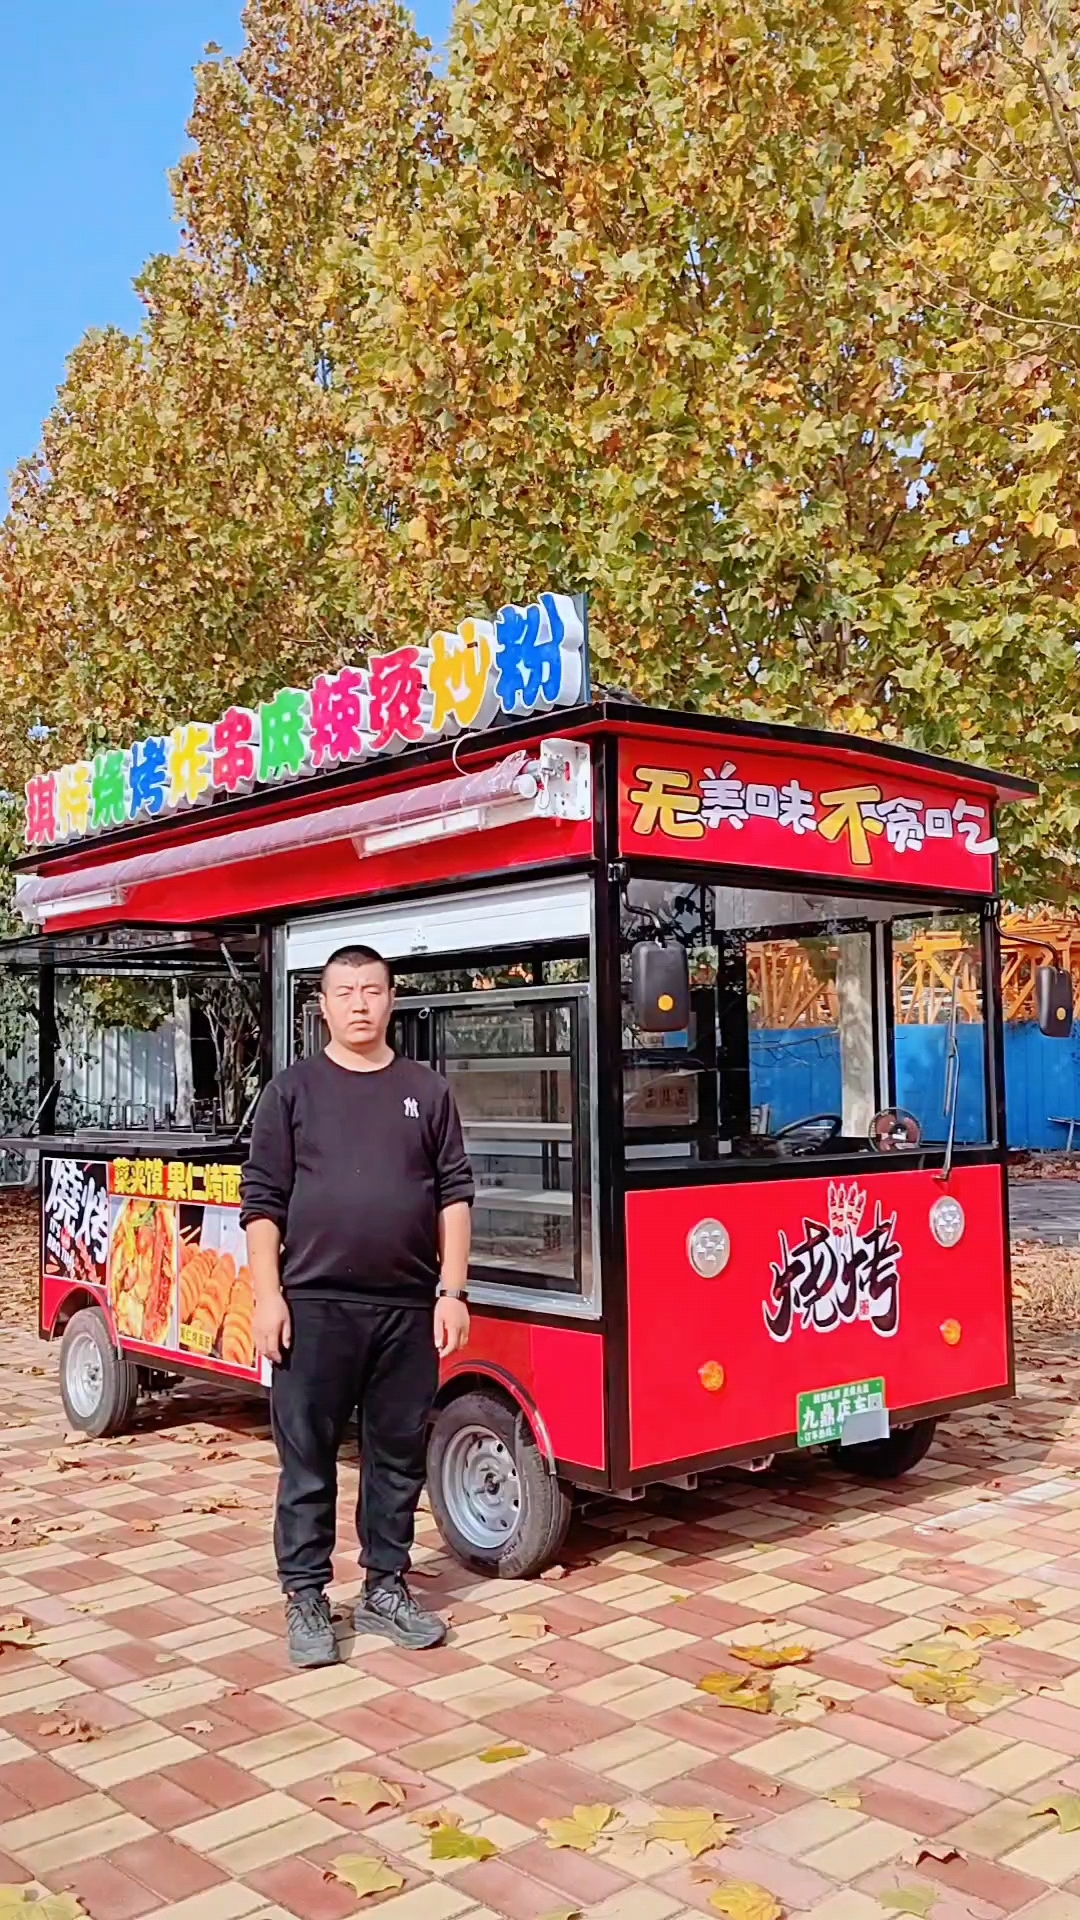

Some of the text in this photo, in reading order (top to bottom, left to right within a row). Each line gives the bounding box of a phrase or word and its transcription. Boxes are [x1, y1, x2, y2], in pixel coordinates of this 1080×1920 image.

[629, 761, 999, 865] 无美味不贪吃
[403, 1096, 420, 1119] NY
[113, 1157, 163, 1196] 菜夹馍
[763, 1200, 903, 1342] 烧烤
